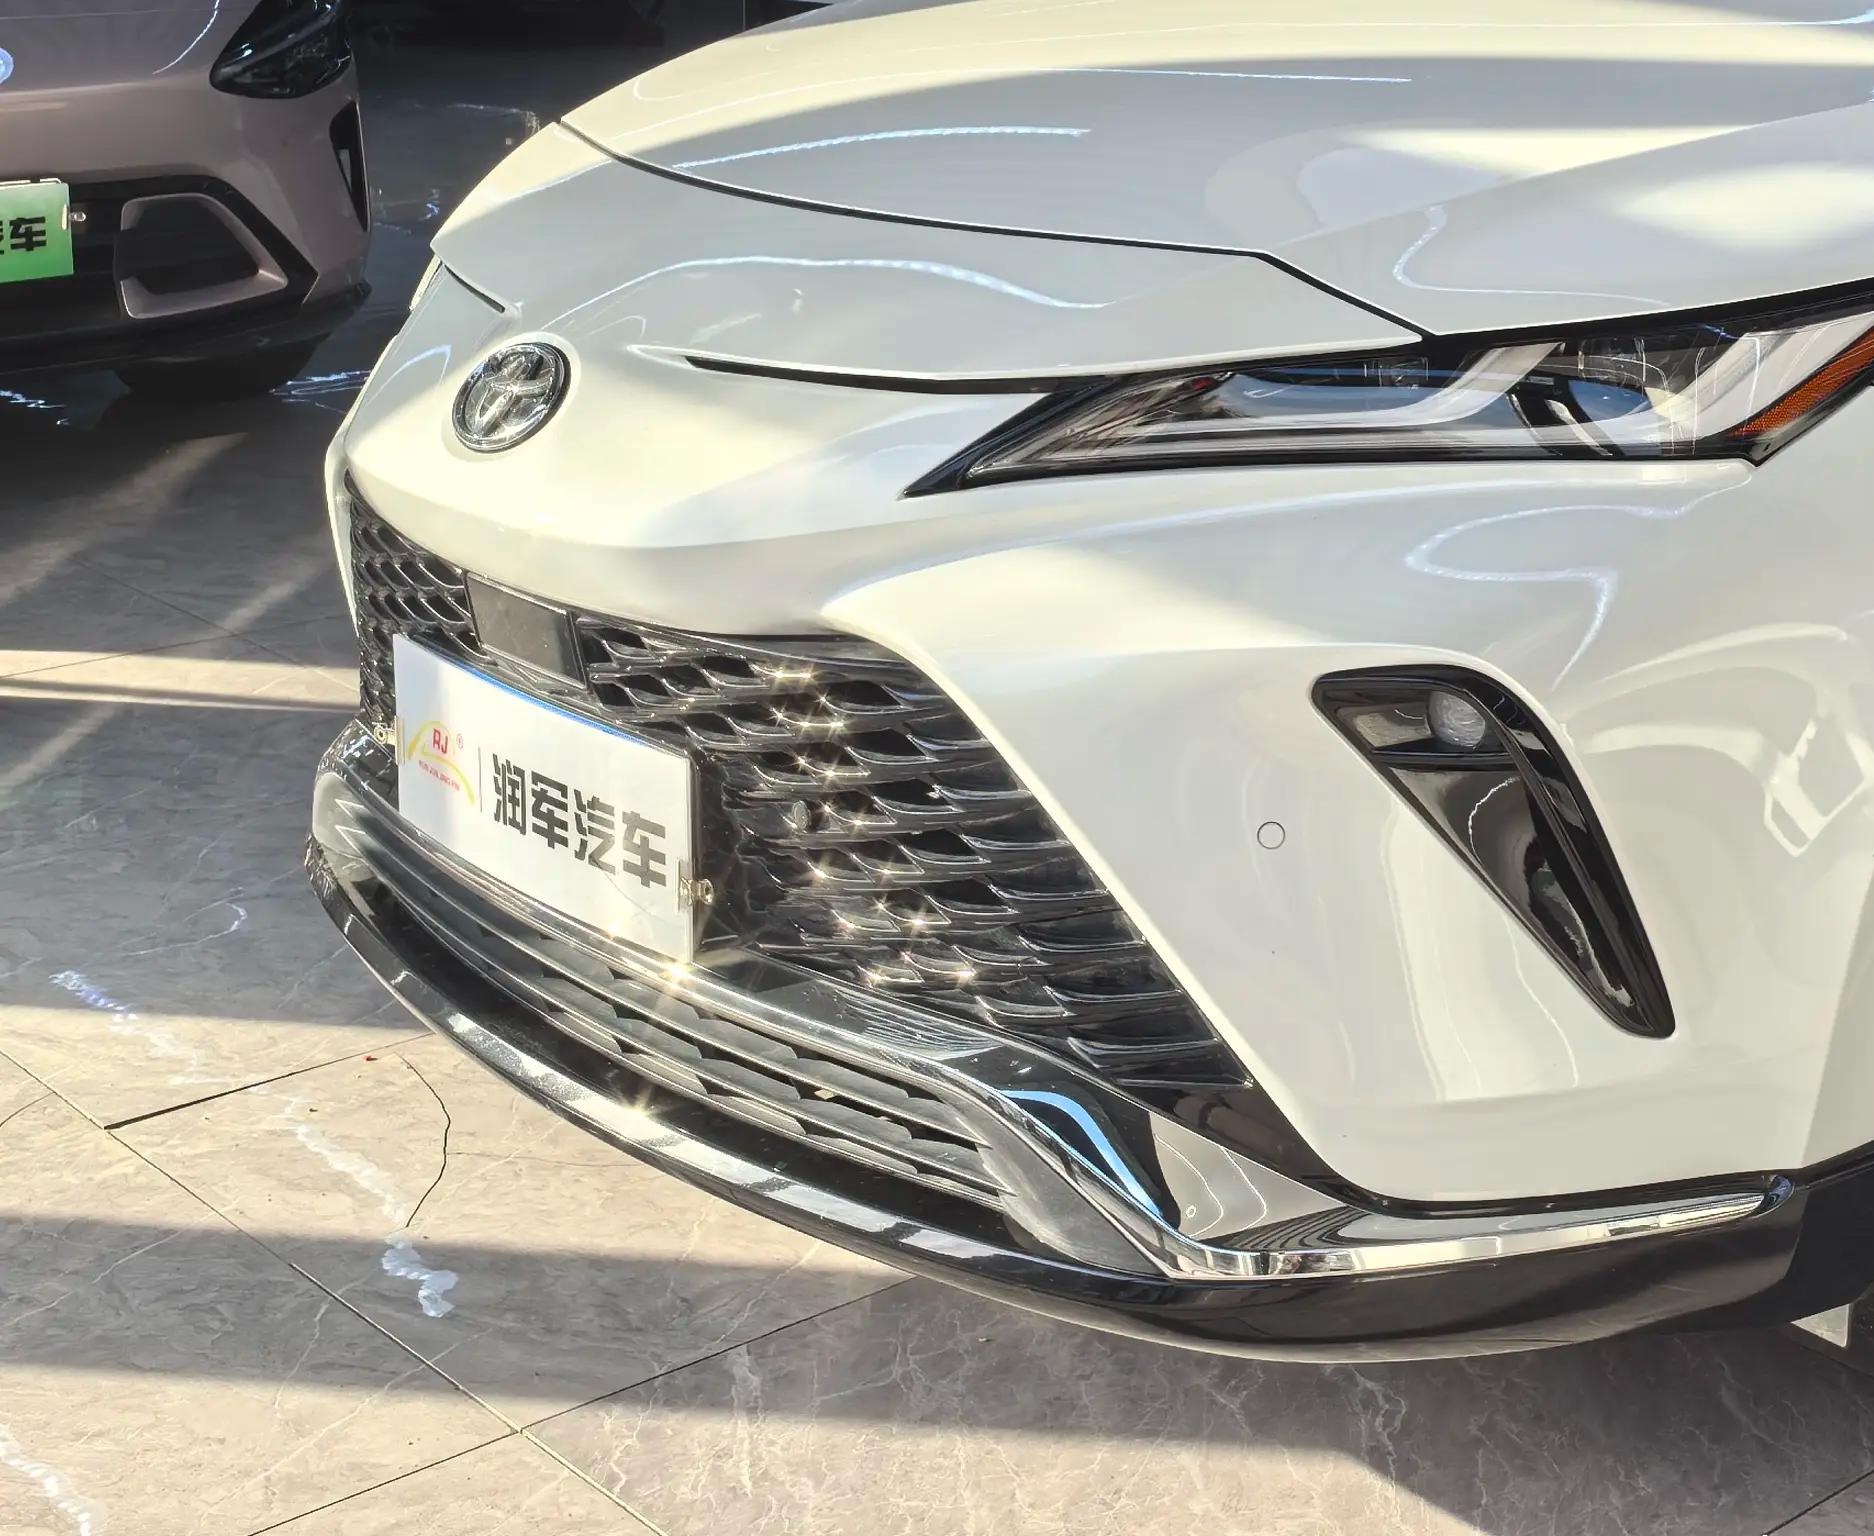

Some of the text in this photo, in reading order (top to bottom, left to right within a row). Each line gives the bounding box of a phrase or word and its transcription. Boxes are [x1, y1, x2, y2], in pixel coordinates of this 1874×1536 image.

[0, 216, 47, 255] 车
[432, 728, 449, 755] RJ
[492, 752, 668, 889] 润军汽车
